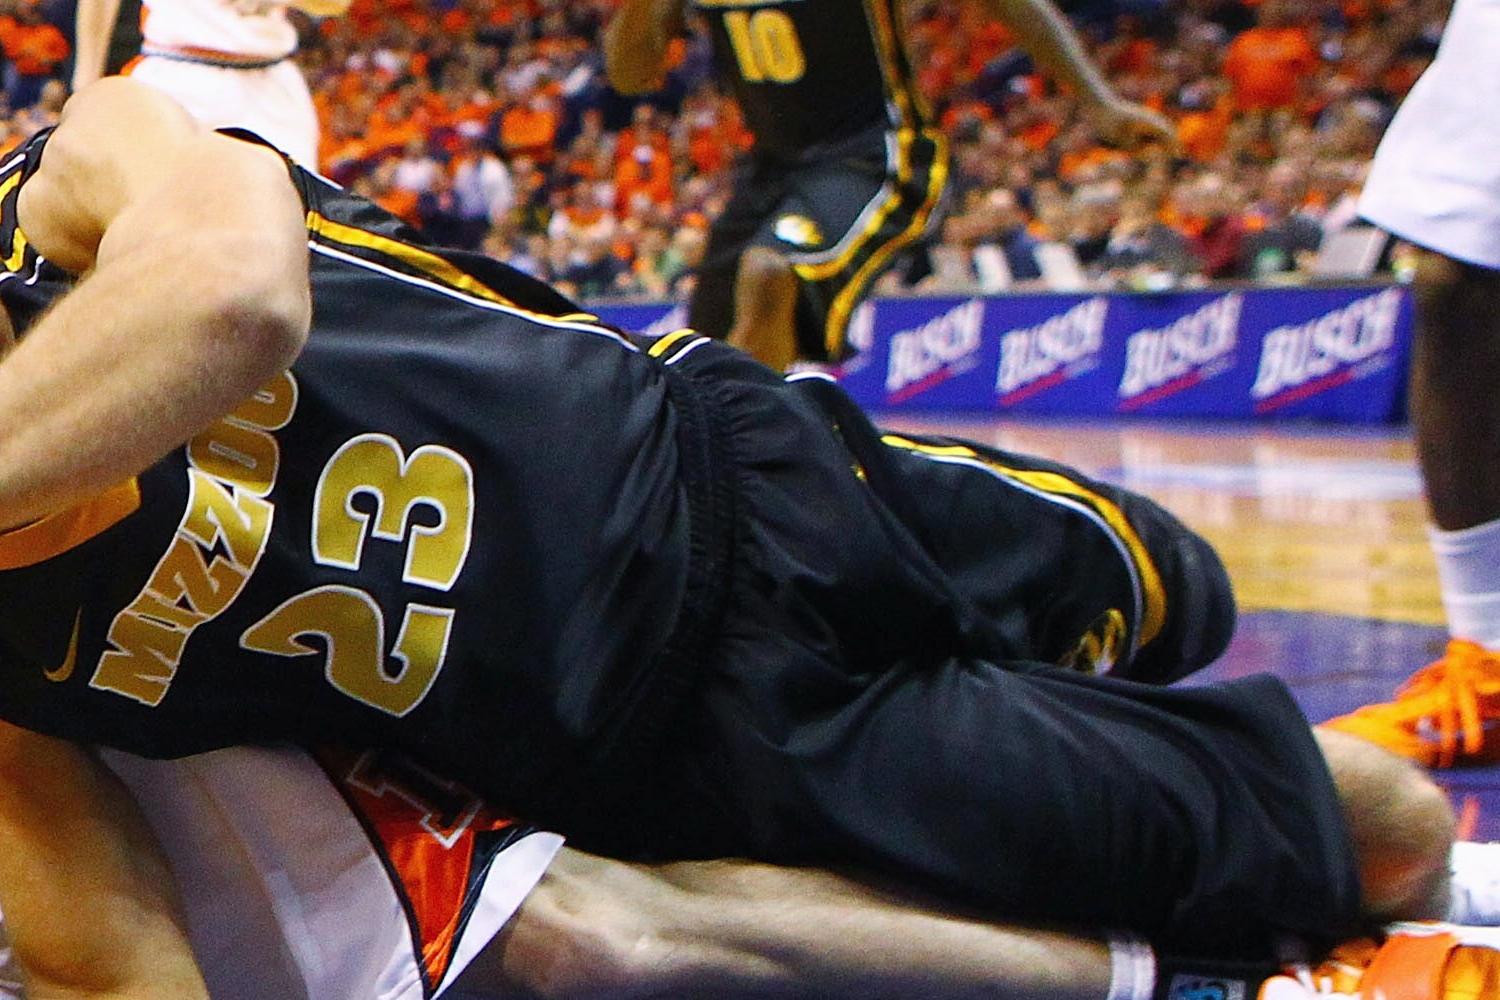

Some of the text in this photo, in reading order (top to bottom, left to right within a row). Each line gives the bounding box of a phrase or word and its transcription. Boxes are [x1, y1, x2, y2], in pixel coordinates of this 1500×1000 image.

[722, 8, 807, 82] 10
[886, 297, 985, 391] BUSCH
[996, 296, 1108, 393] BUSCH
[1118, 290, 1245, 397] BUSCH
[1252, 286, 1404, 396] BUSCH
[239, 432, 475, 718] 23
